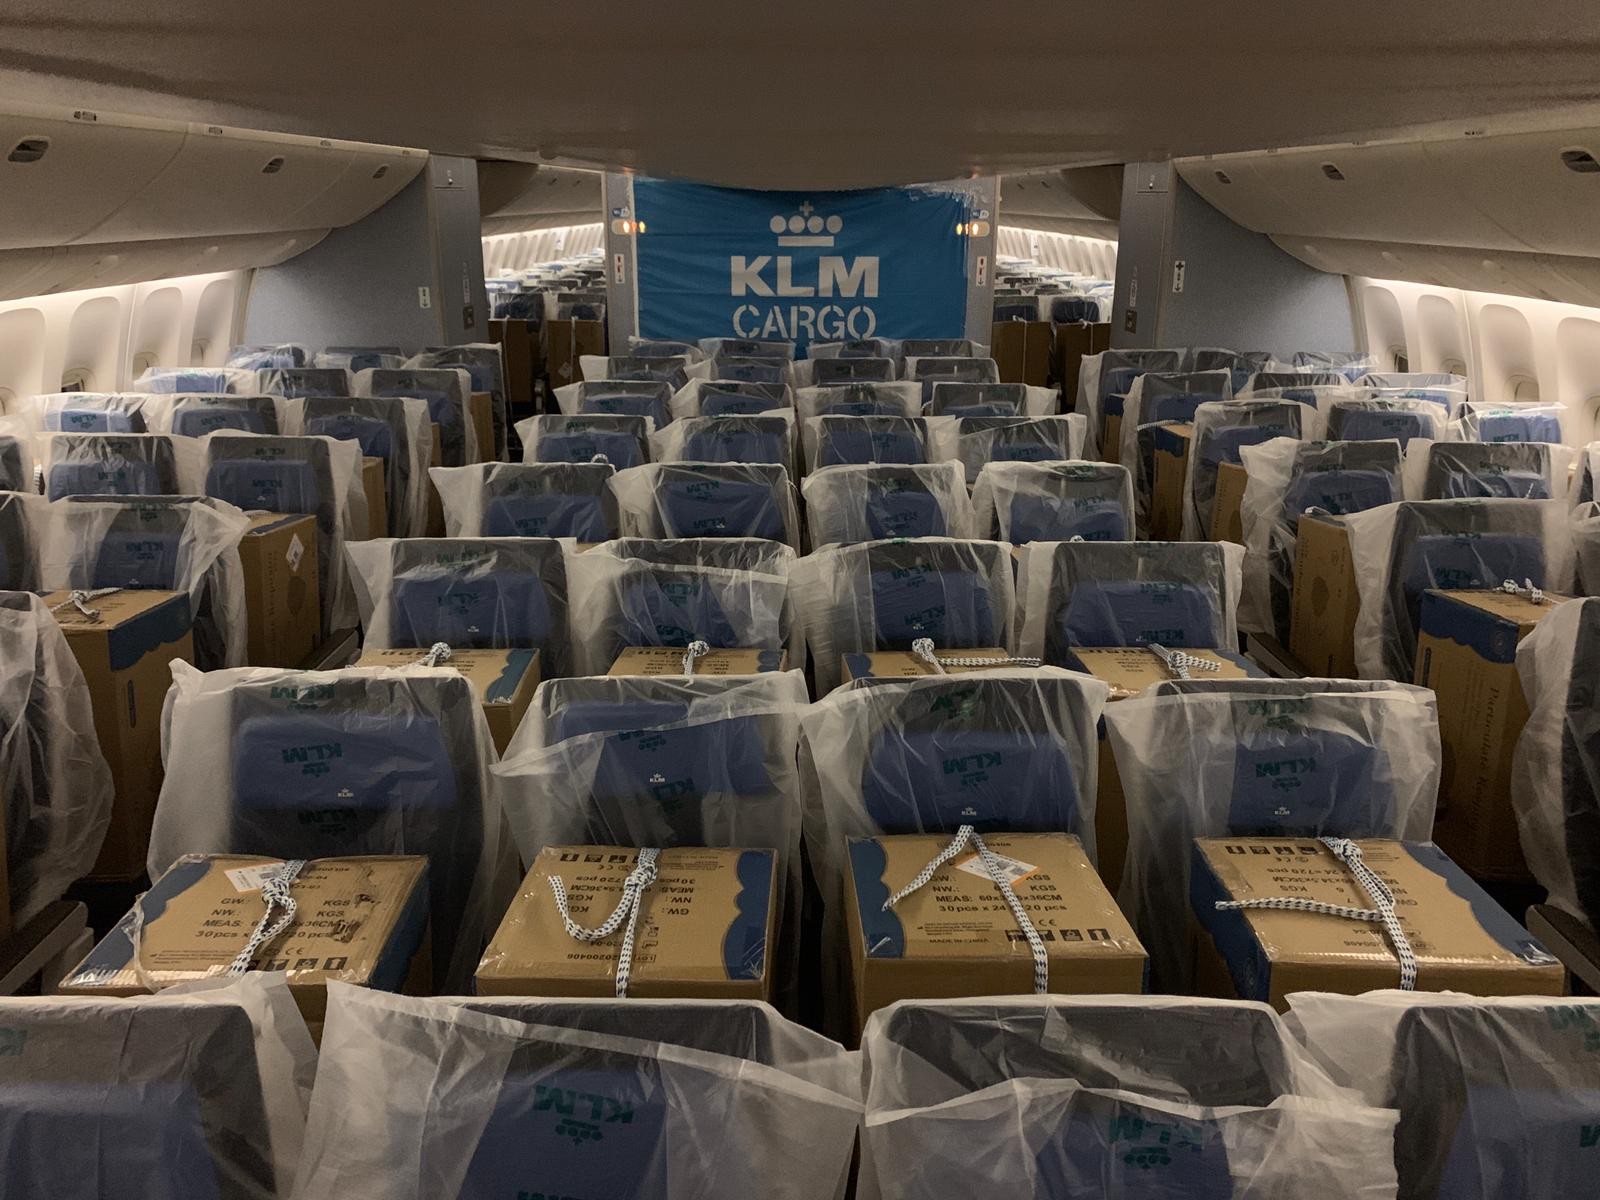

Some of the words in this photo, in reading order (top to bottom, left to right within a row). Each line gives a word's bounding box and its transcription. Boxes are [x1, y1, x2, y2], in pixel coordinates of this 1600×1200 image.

[730, 255, 879, 298] KLM
[732, 304, 877, 340] CARGO
[282, 743, 343, 763] KLM
[943, 751, 1002, 774] KLM
[1255, 757, 1317, 777] KLM
[1045, 905, 1068, 913] pcs
[533, 1084, 634, 1124] KLM
